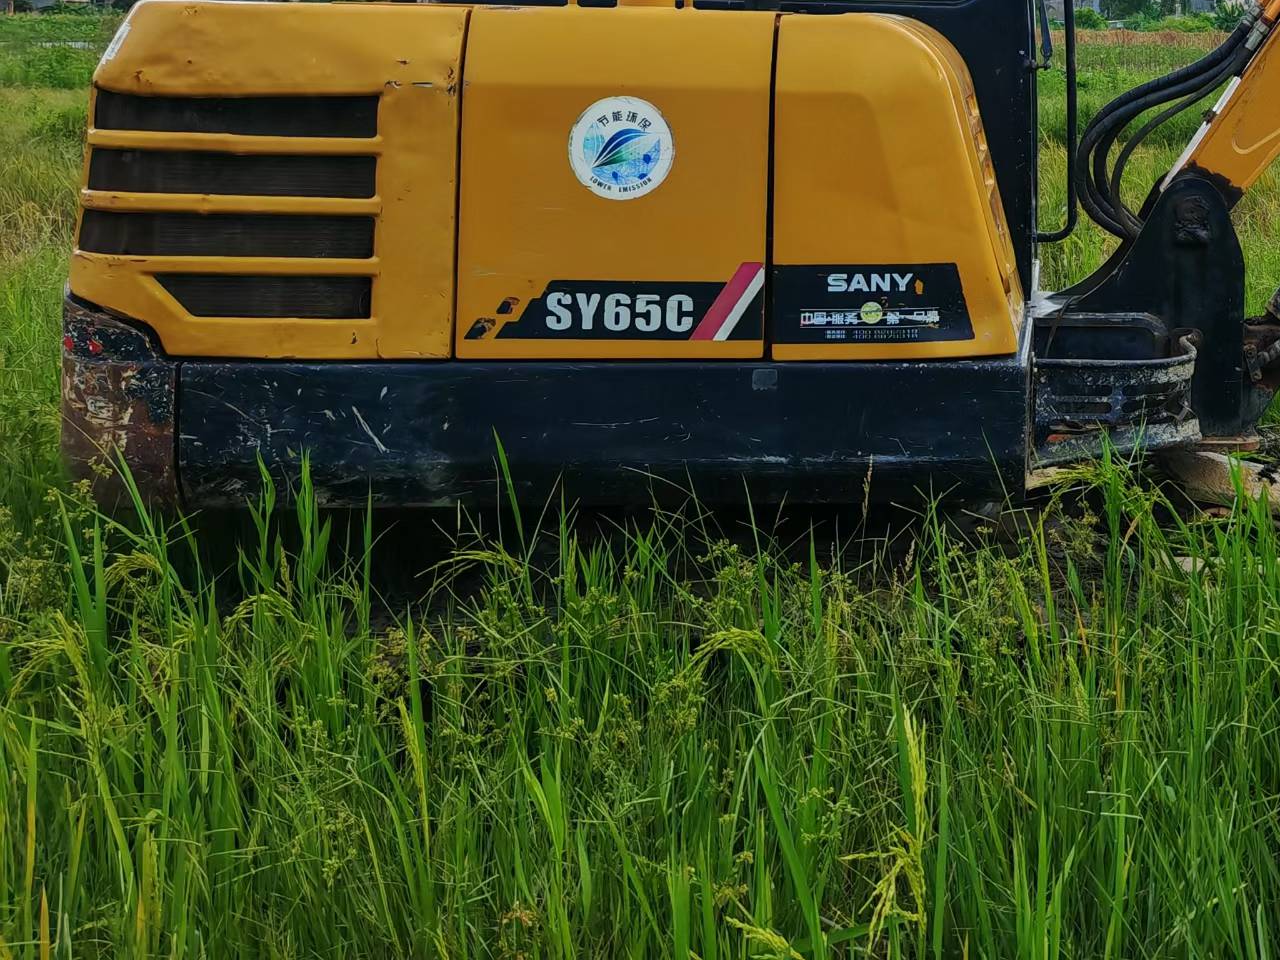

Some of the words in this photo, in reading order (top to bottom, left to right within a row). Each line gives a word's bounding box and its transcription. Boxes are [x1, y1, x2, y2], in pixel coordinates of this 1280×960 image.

[596, 110, 652, 132] 节能环保
[589, 175, 612, 191] LOWER
[618, 177, 652, 193] EMISSION
[827, 273, 914, 292] SANY
[545, 292, 694, 333] SY65C
